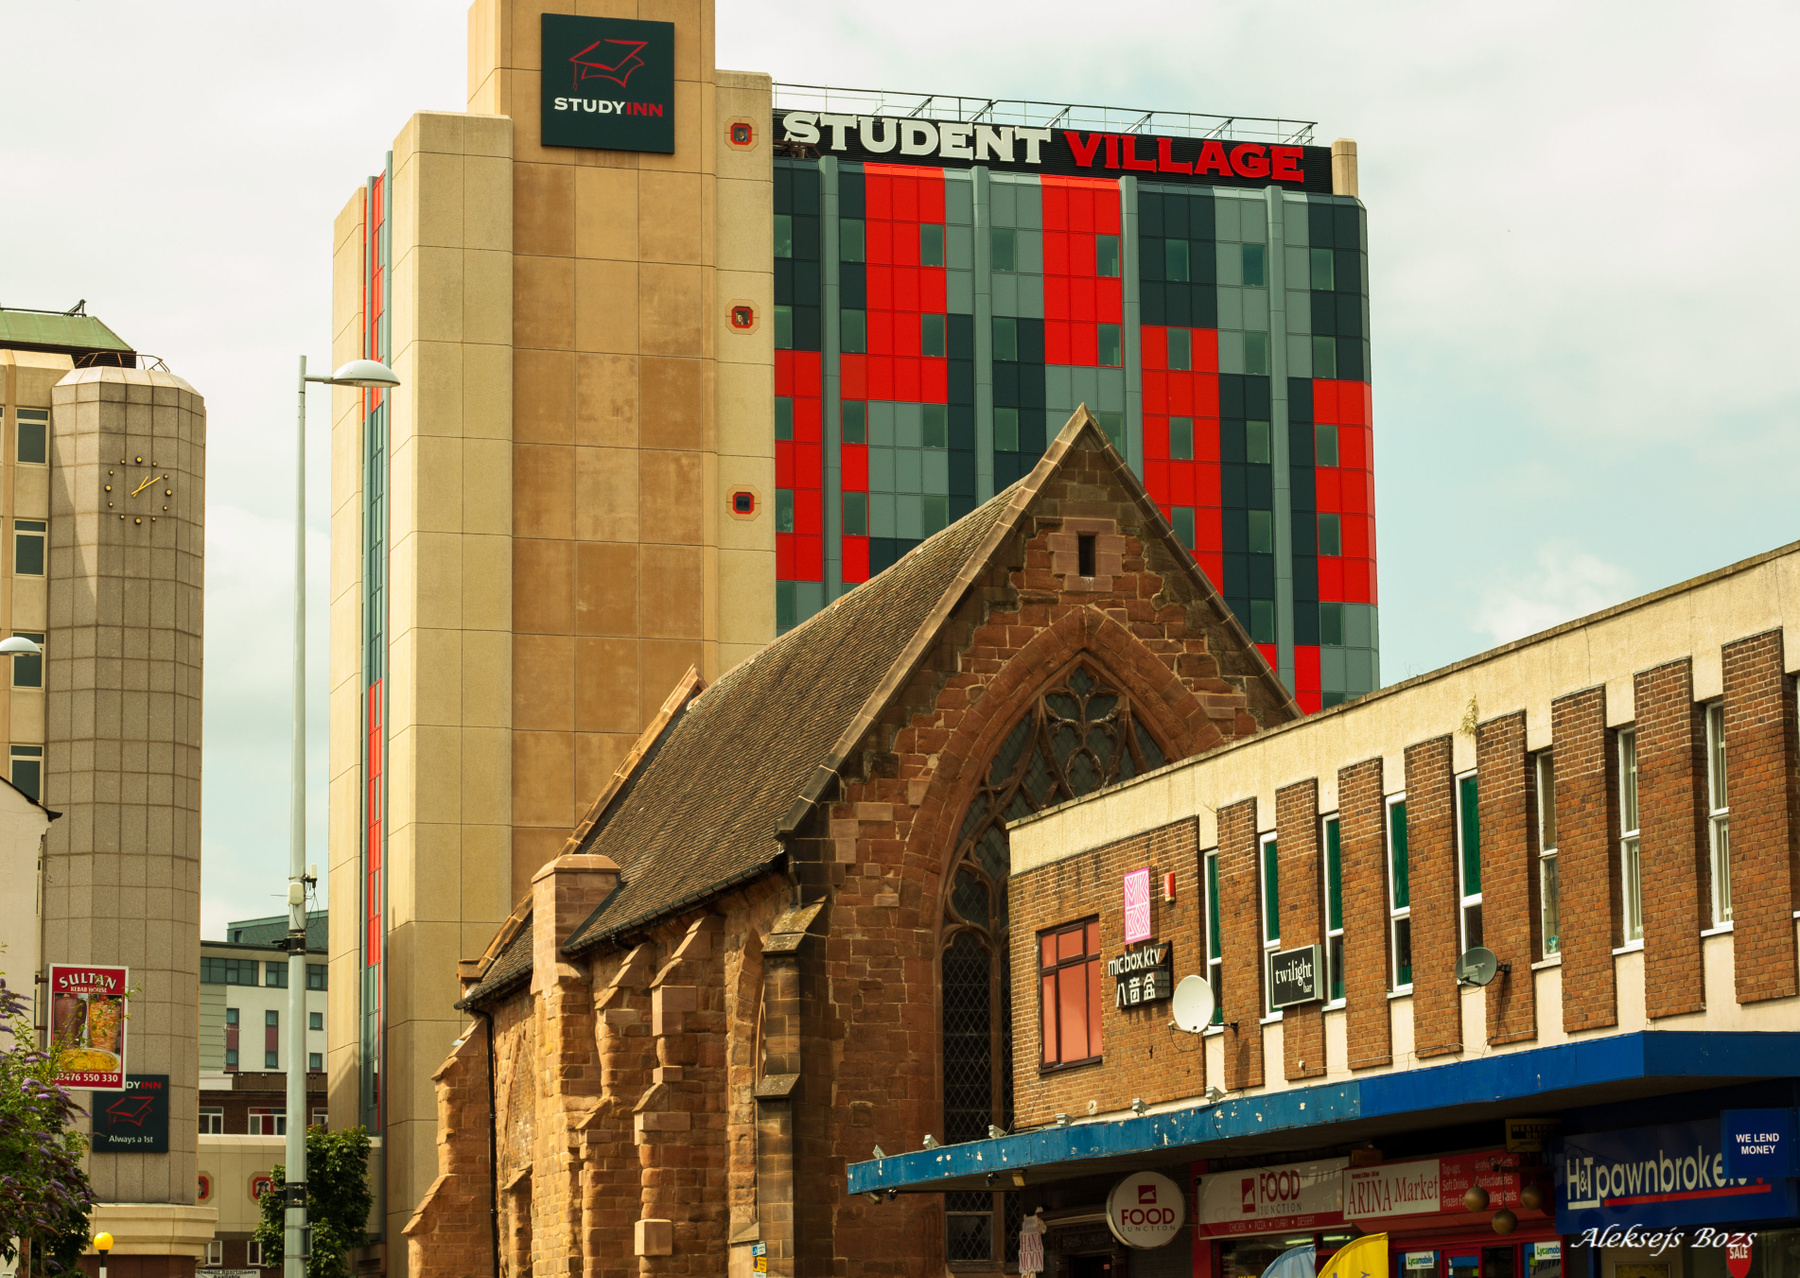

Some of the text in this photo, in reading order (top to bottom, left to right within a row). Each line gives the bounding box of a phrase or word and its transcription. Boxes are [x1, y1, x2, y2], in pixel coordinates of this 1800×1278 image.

[783, 111, 1305, 182] STUDENT VILLAGE
[1143, 945, 1161, 968] ktv
[1275, 957, 1312, 986] twilight
[58, 972, 118, 990] SULTAN
[1303, 982, 1312, 993] bar
[70, 985, 87, 993] KEBAB
[1116, 972, 1156, 1008] 八音盒
[83, 1073, 100, 1082] 550
[101, 1074, 118, 1083] 330
[126, 1081, 161, 1090] DYINN
[108, 1134, 136, 1144] Always
[143, 1135, 153, 1144] 1st
[1735, 1132, 1780, 1144] WE LEND
[1740, 1144, 1776, 1155] MONEY
[1442, 1163, 1462, 1177] Top-ups
[1567, 1144, 1748, 1208] H&T pawnbroke
[1260, 1169, 1301, 1204] FOOD
[1442, 1178, 1468, 1191] Soft Drinks
[1347, 1174, 1440, 1216] ARINA Market
[1442, 1195, 1458, 1207] Frozen
[1260, 1201, 1302, 1215] JUNCTION
[1121, 1208, 1175, 1225] FOOD
[1228, 1216, 1315, 1233] CHICKEN PIZZA CURRY DESSERT
[1020, 1233, 1043, 1252] HANA
[1729, 1246, 1749, 1260] SALE
[1019, 1251, 1044, 1271] MOON
[1407, 1254, 1433, 1267] Lycamobile
